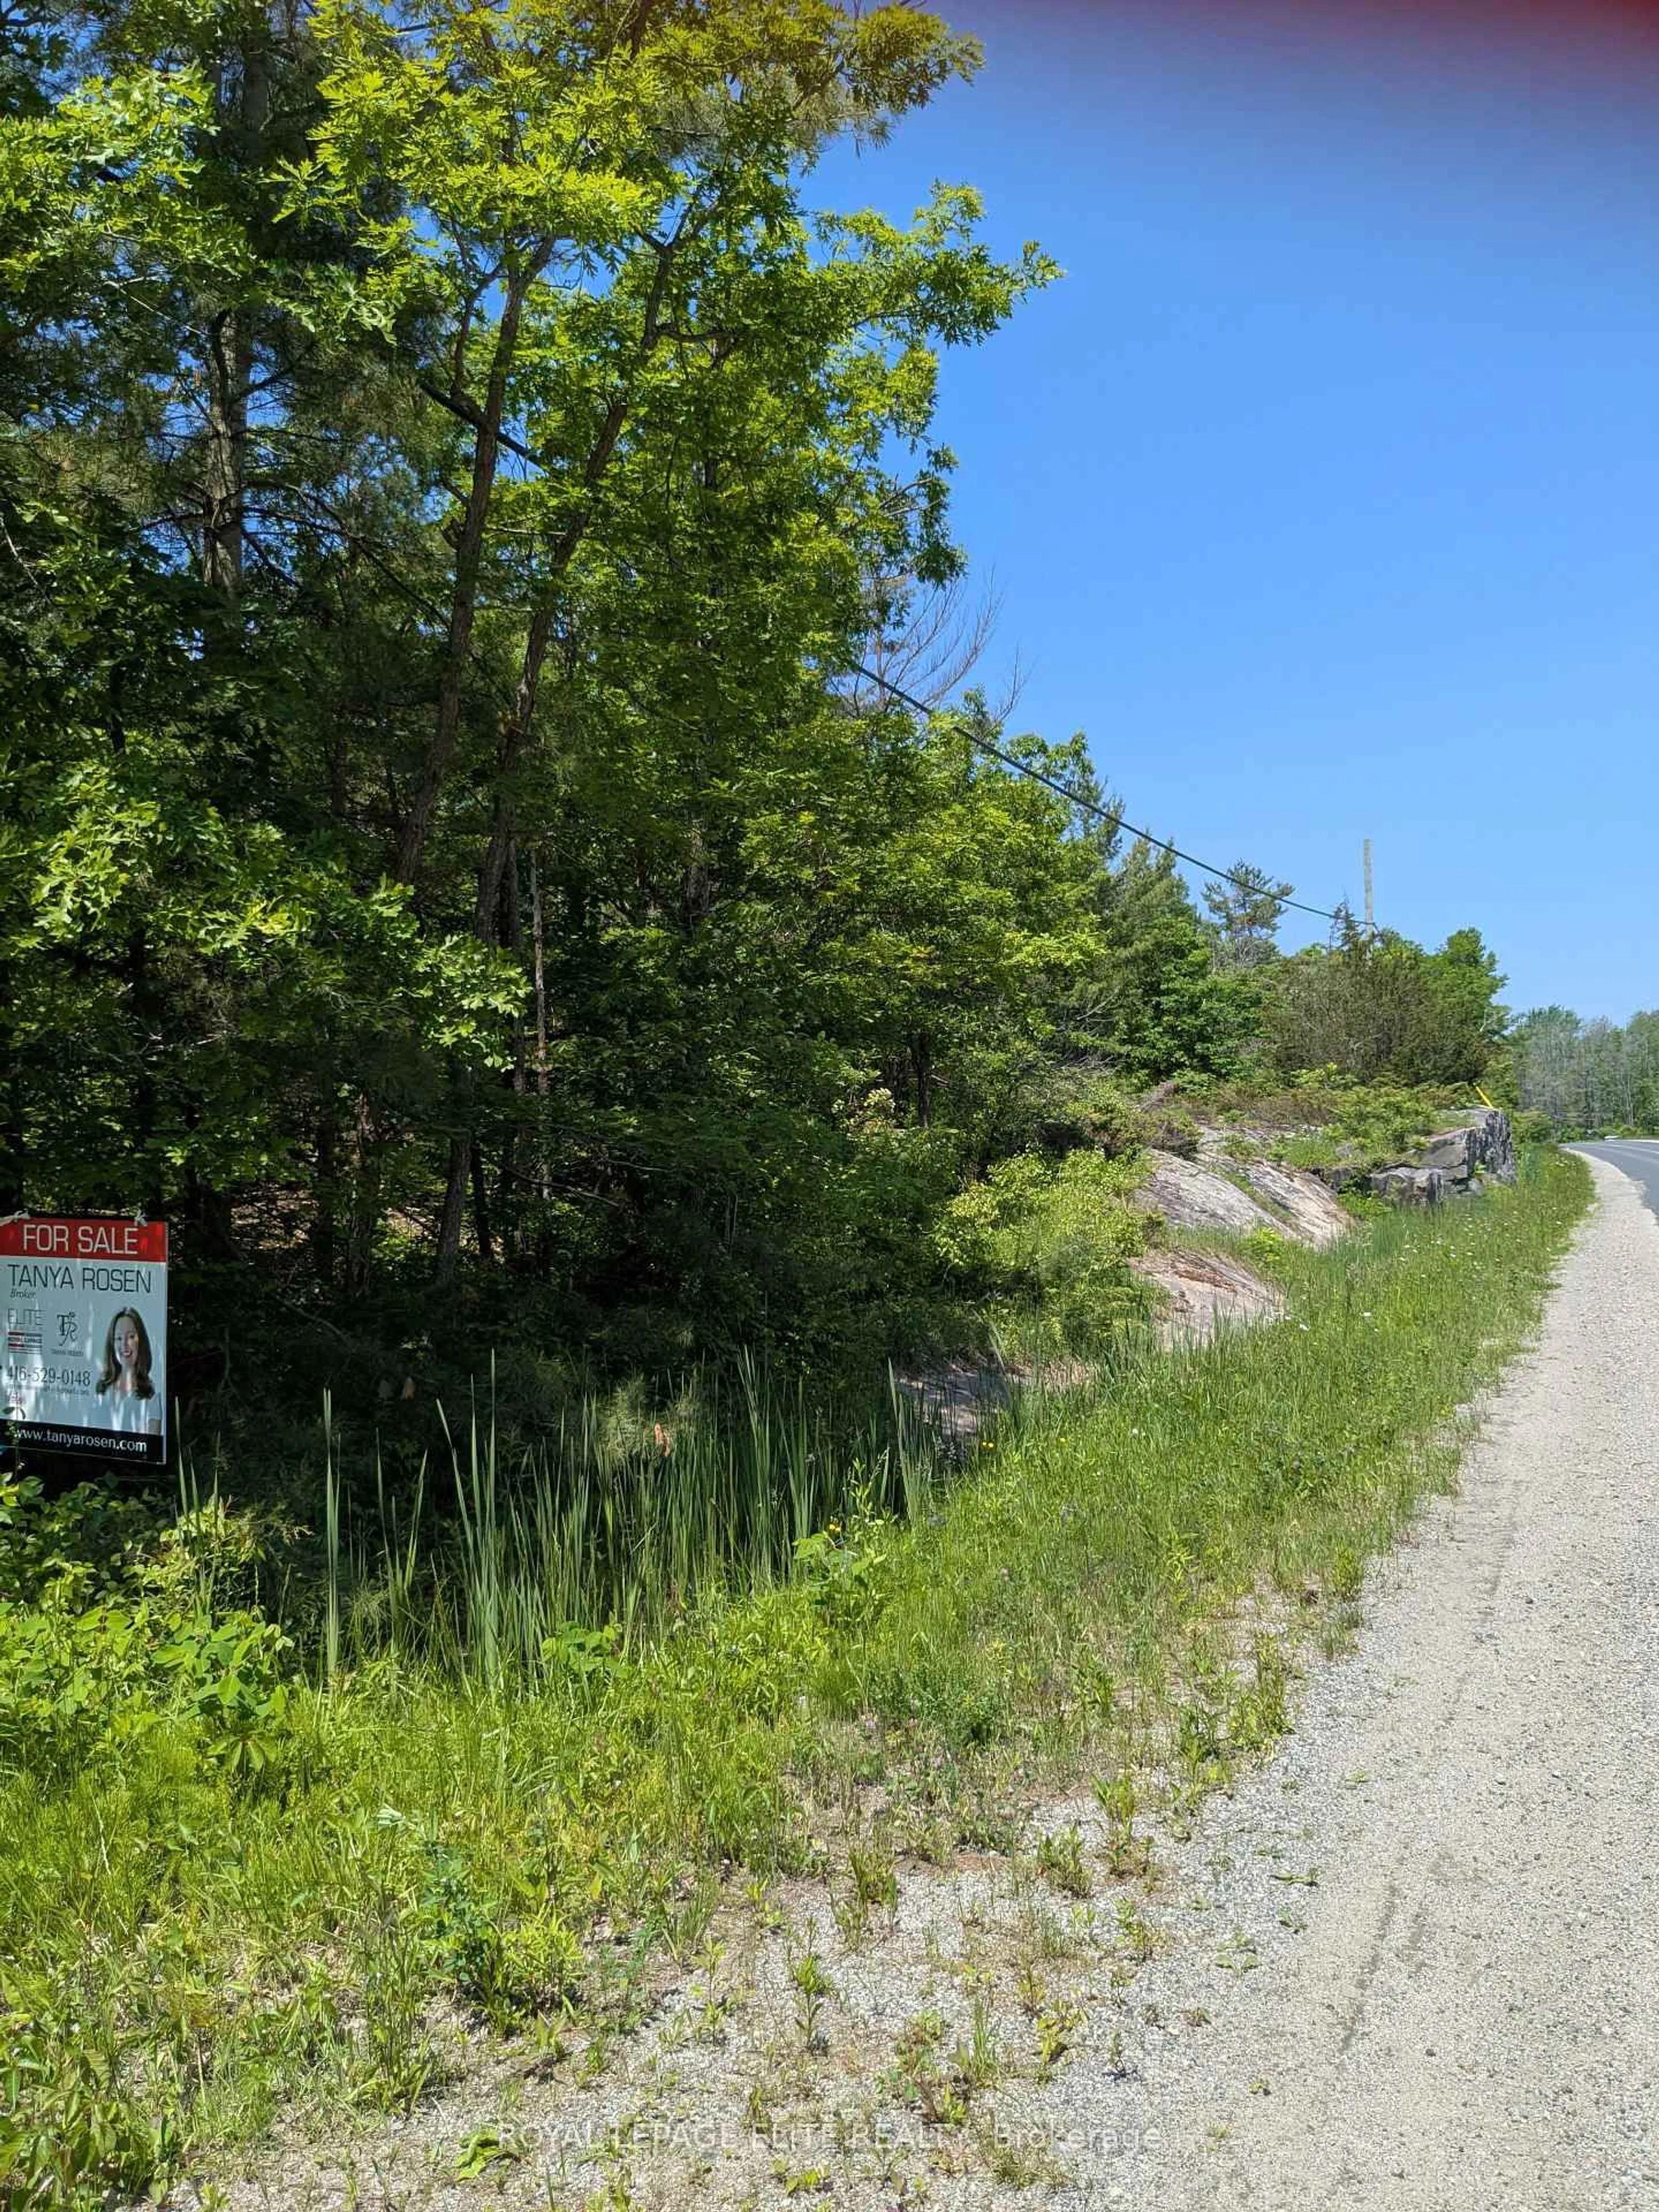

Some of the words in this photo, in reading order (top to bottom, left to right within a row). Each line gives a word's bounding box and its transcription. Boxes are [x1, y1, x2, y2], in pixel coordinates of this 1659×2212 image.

[23, 1224, 69, 1252] FOR
[78, 1226, 139, 1255] SALE
[7, 1264, 74, 1289] TANYA
[82, 1267, 153, 1294] ROSEN
[10, 1288, 36, 1298] Broker
[7, 1365, 92, 1387] 416-529-0148
